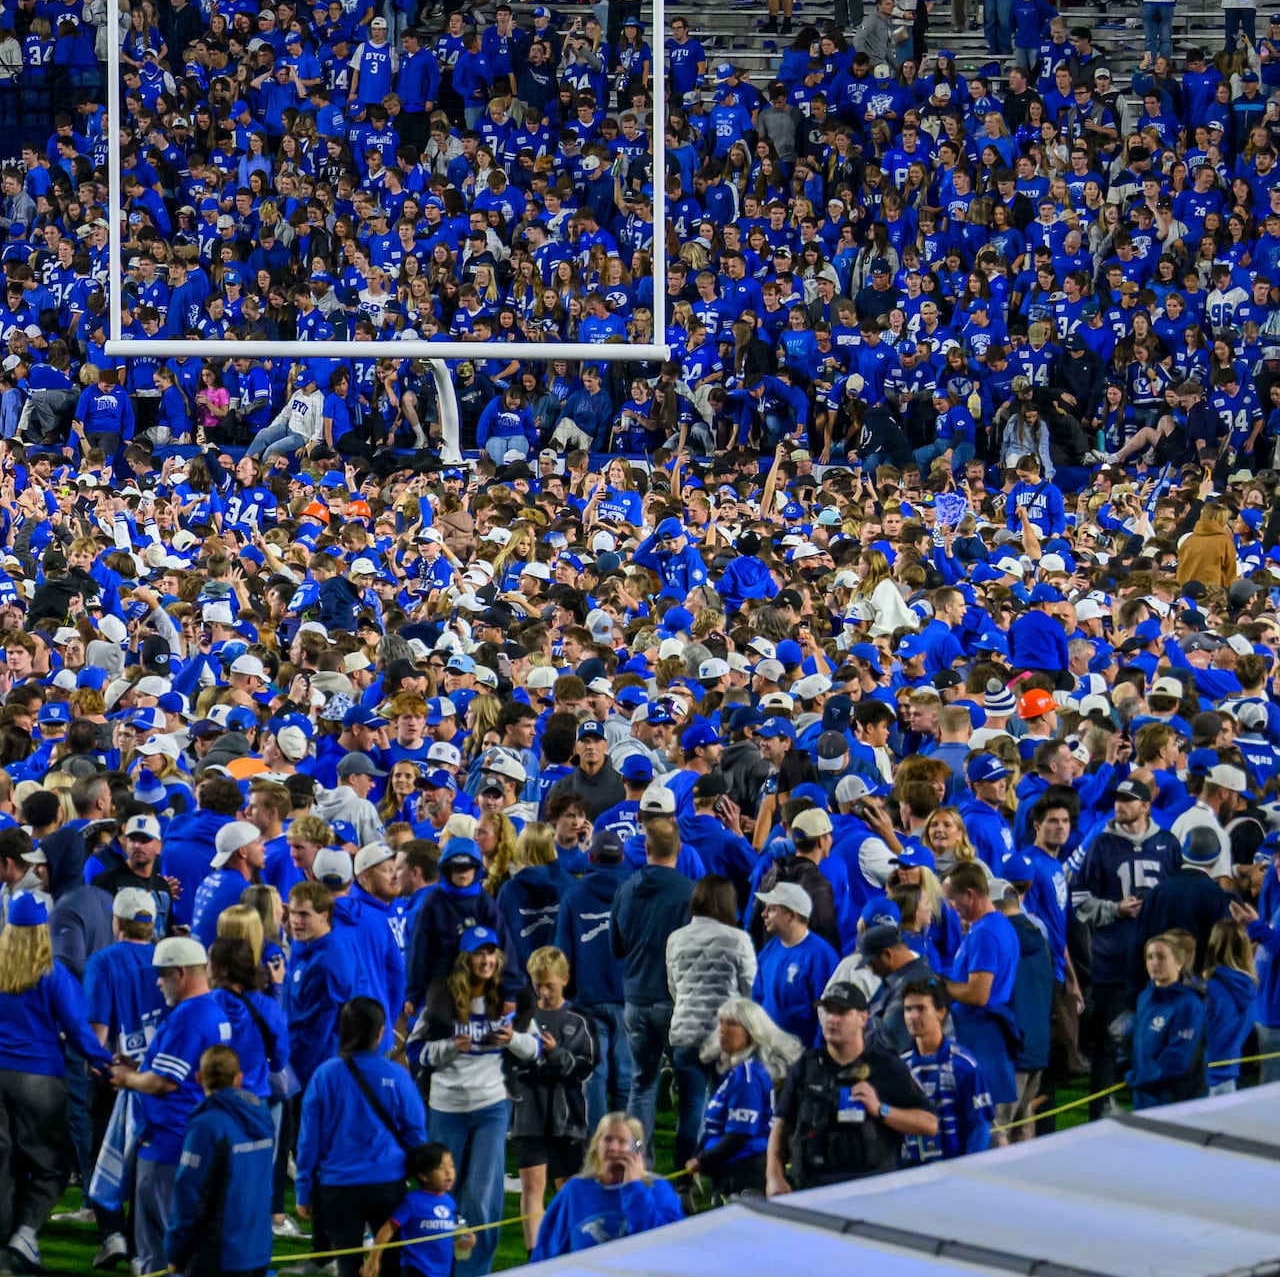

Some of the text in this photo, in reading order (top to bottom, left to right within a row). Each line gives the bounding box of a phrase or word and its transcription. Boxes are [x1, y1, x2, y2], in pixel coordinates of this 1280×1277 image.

[28, 44, 53, 66] 34
[365, 52, 385, 63] BYU
[671, 48, 689, 60] BYU
[370, 63, 378, 75] 3
[326, 71, 345, 90] 34
[617, 147, 644, 156] BYU
[1195, 206, 1206, 217] 26
[1210, 303, 1233, 325] 96
[355, 362, 375, 384] 34
[291, 398, 309, 416] BYU
[1220, 409, 1249, 433] 34
[225, 495, 259, 528] 34
[599, 502, 628, 515] AMERICA
[1117, 858, 1162, 902] 15
[727, 1107, 759, 1124] M37
